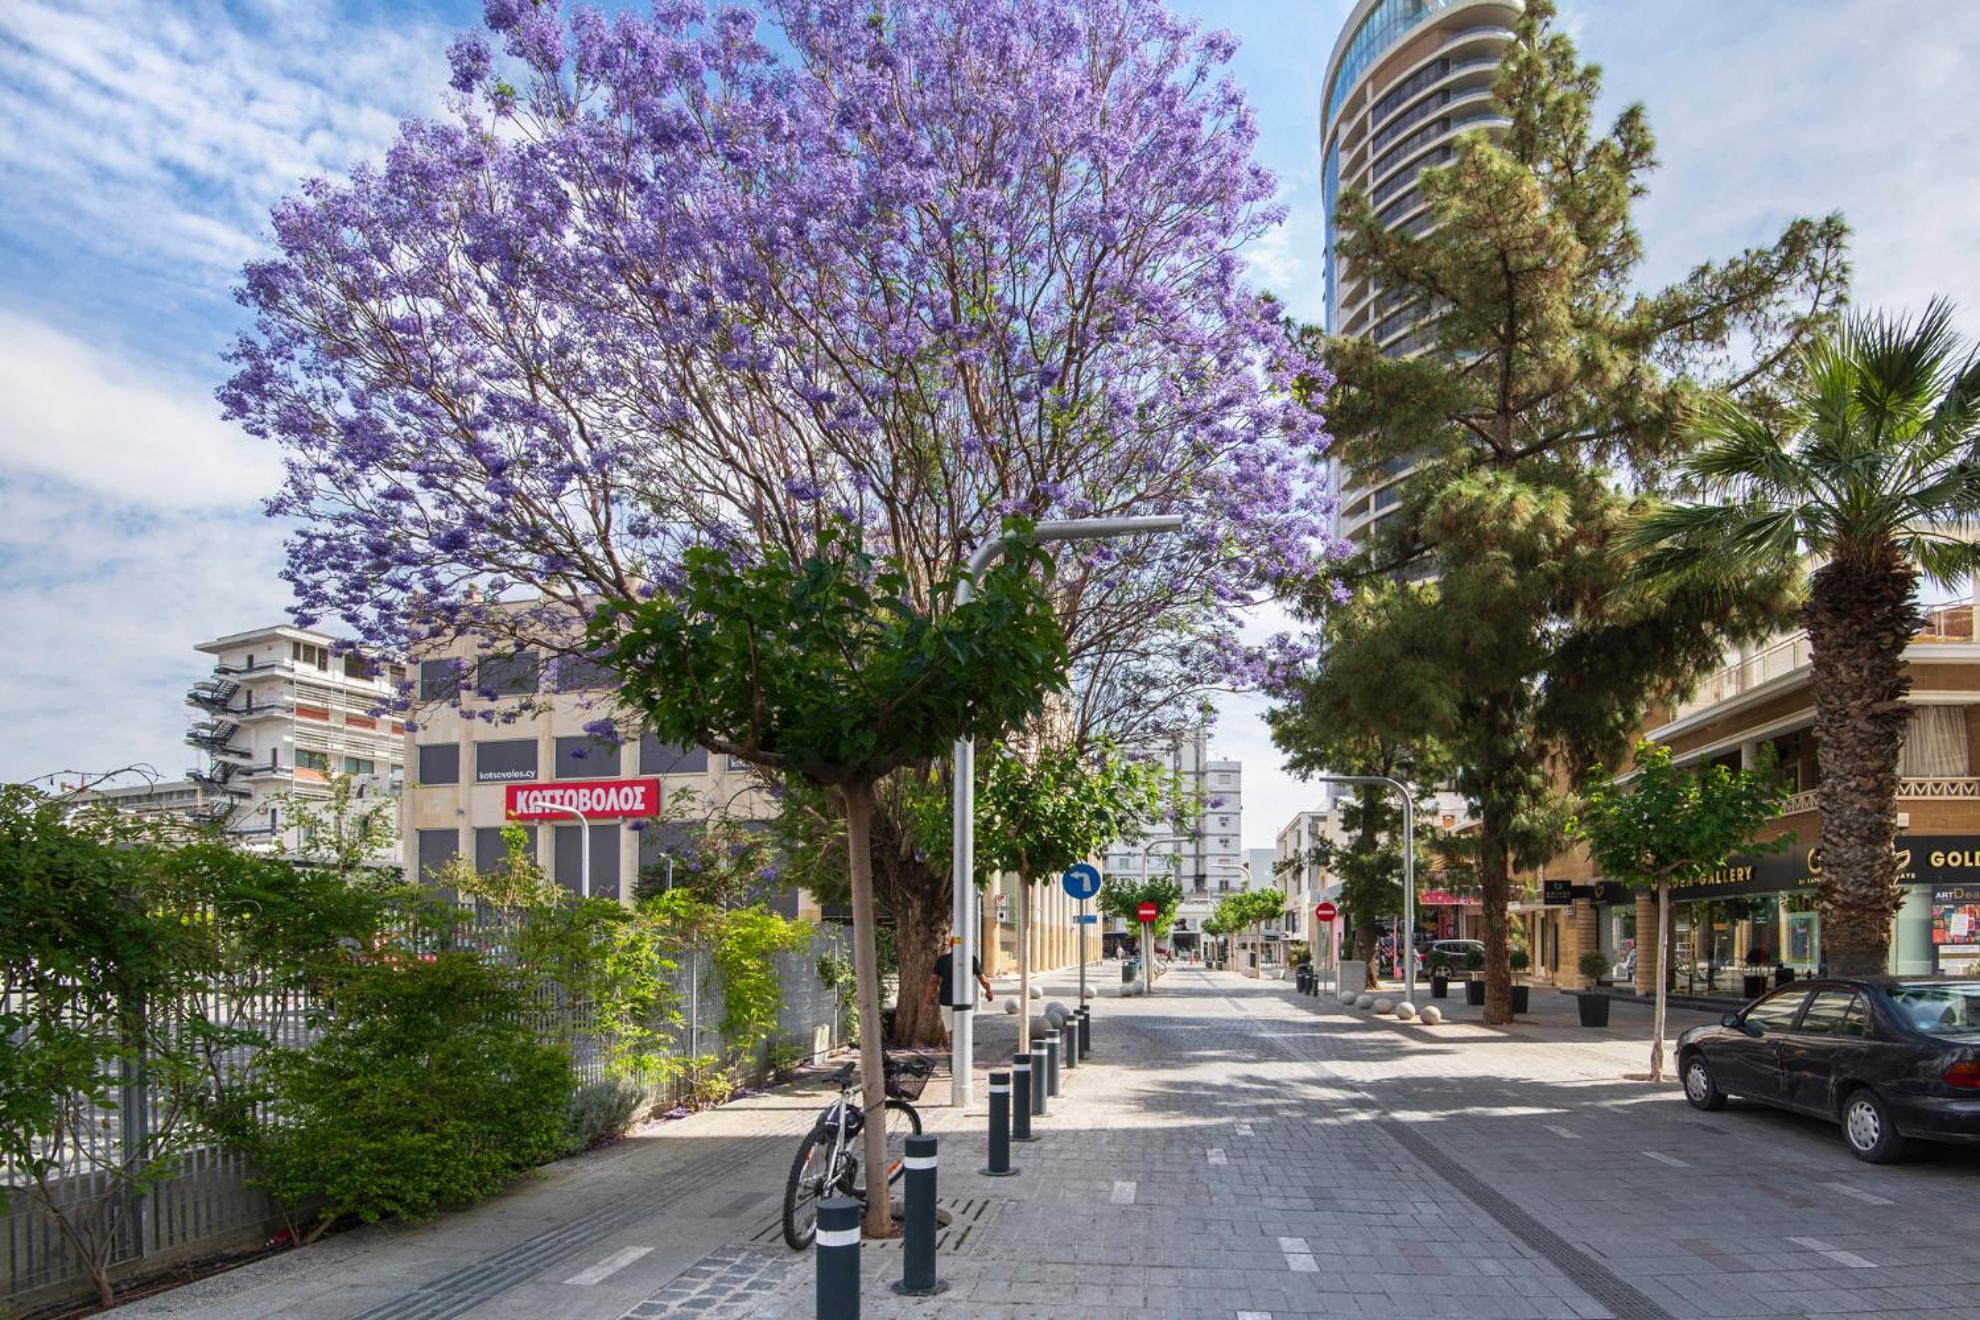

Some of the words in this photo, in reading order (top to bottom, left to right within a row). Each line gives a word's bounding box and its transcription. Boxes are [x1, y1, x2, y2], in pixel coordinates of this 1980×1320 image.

[480, 770, 536, 780] kotsovolos.cy
[516, 786, 645, 814] ΚΩΤΣΟΒΟΛΟΣ
[1700, 866, 1752, 885] GALLERY
